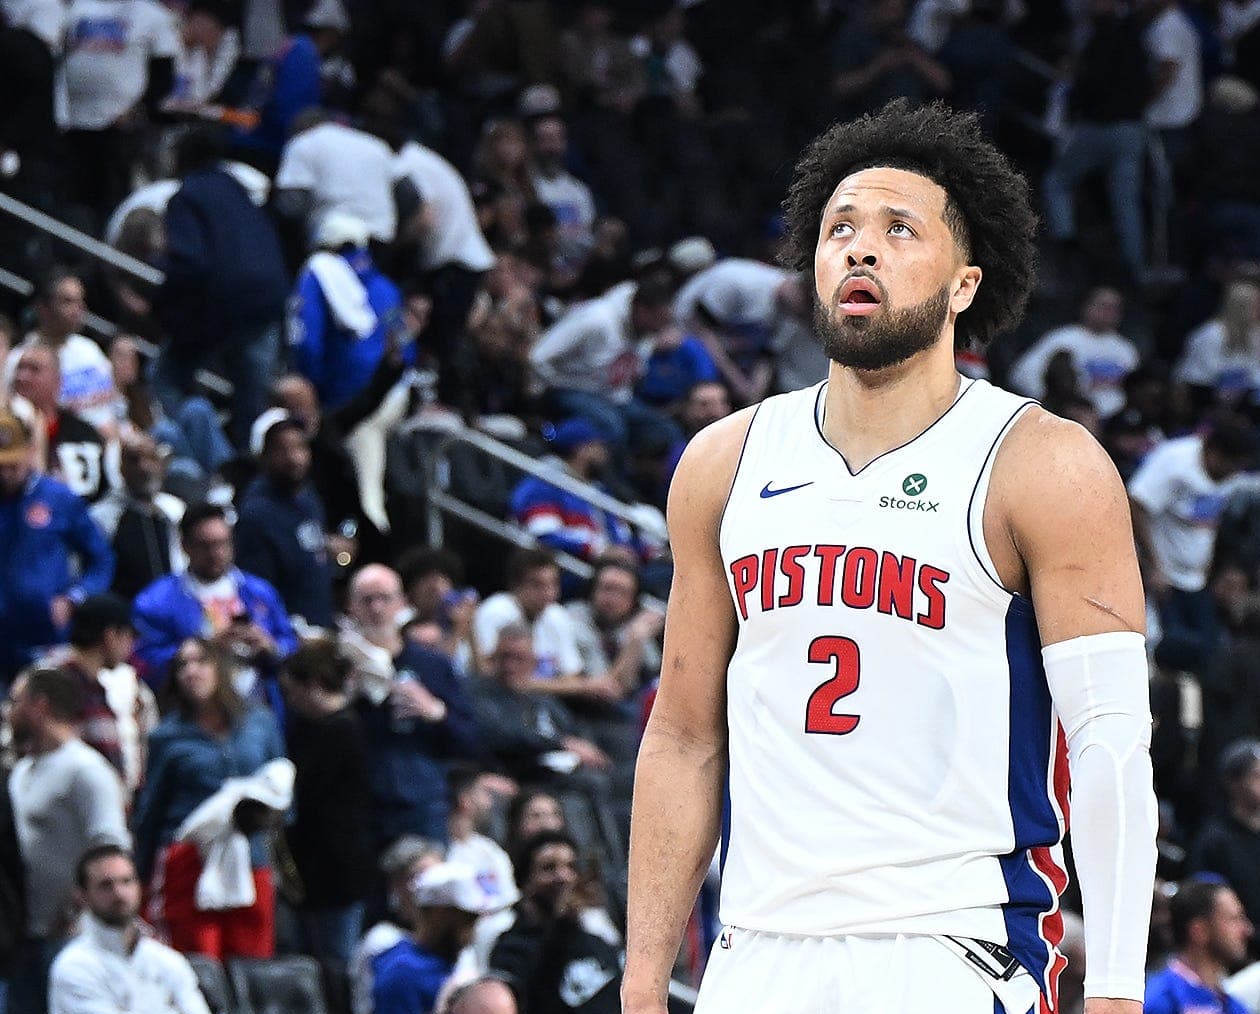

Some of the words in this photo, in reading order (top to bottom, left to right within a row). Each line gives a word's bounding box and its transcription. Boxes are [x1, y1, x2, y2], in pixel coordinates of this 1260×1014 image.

[879, 496, 940, 512] StockX
[730, 544, 950, 630] PISTONS
[805, 635, 861, 735] 2
